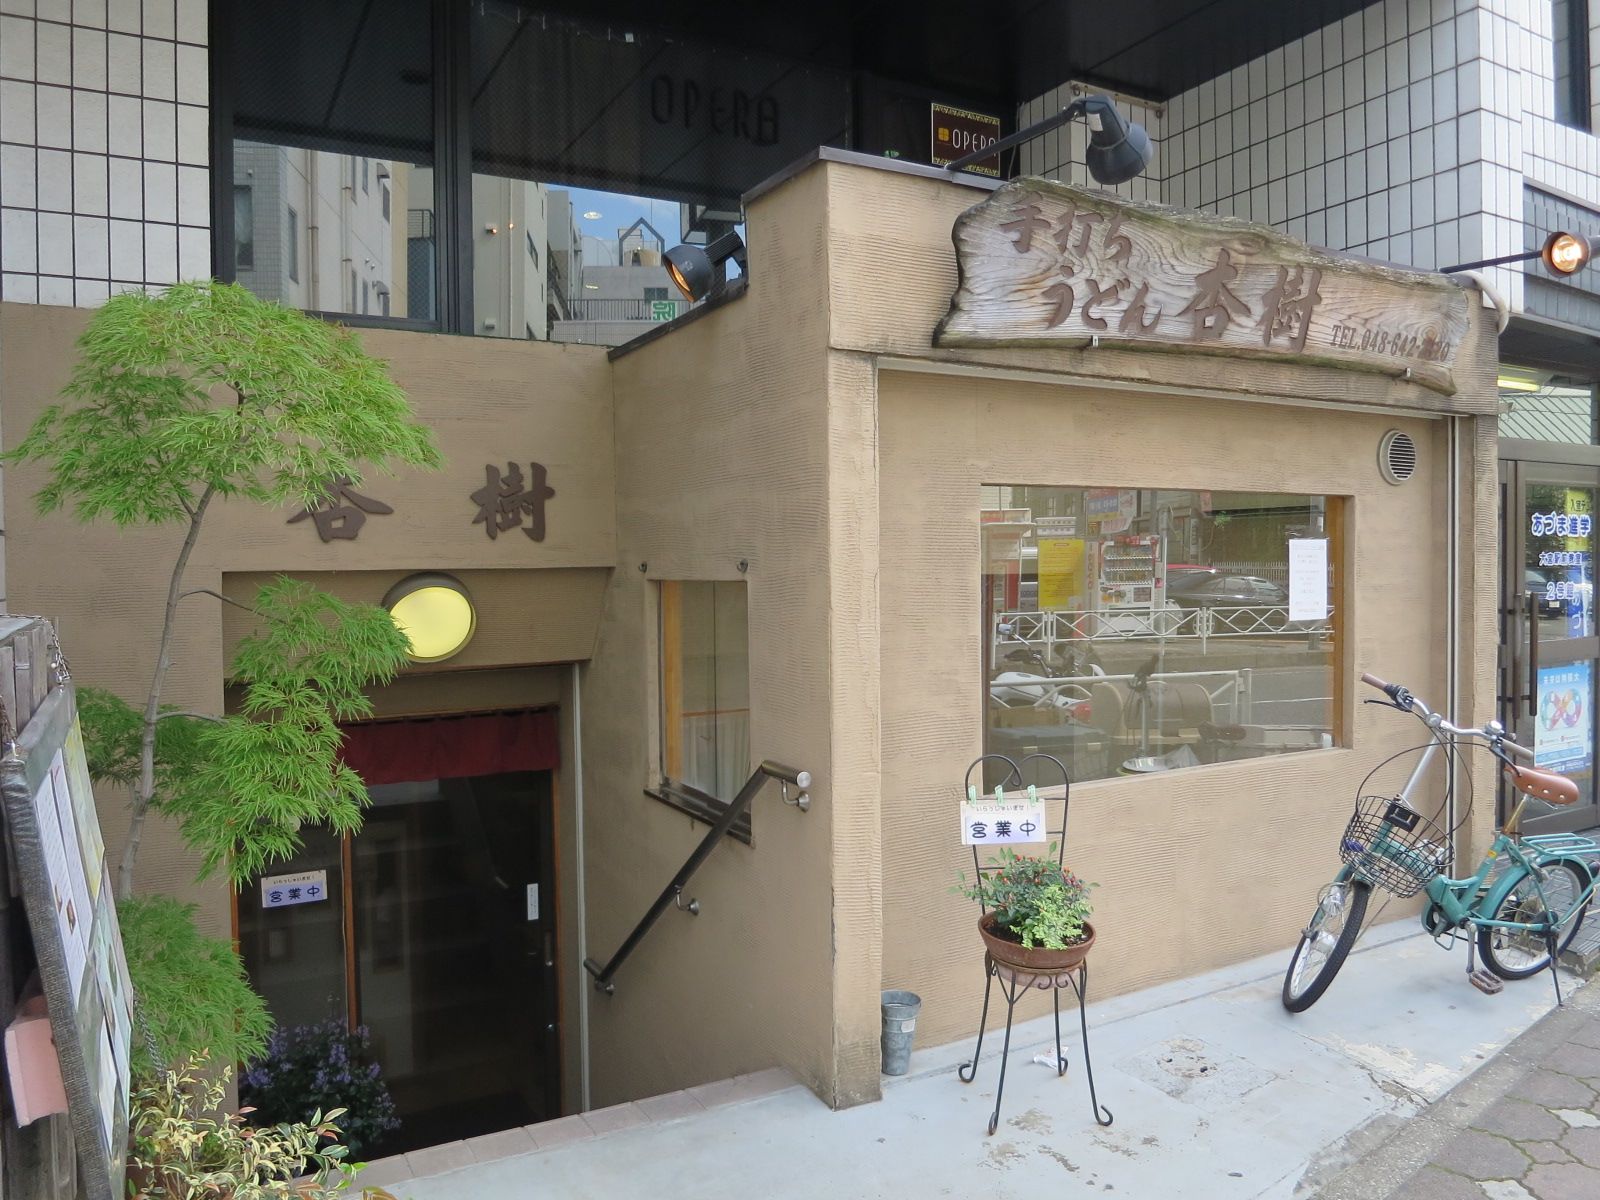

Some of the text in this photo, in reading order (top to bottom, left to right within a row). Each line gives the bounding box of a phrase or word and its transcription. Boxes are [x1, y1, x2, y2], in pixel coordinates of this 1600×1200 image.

[999, 192, 1133, 262] 手打ち
[1041, 265, 1164, 335] うどん
[1176, 248, 1322, 350] 杏樹
[970, 819, 1036, 838] 営業中
[269, 885, 320, 903] 営業中
